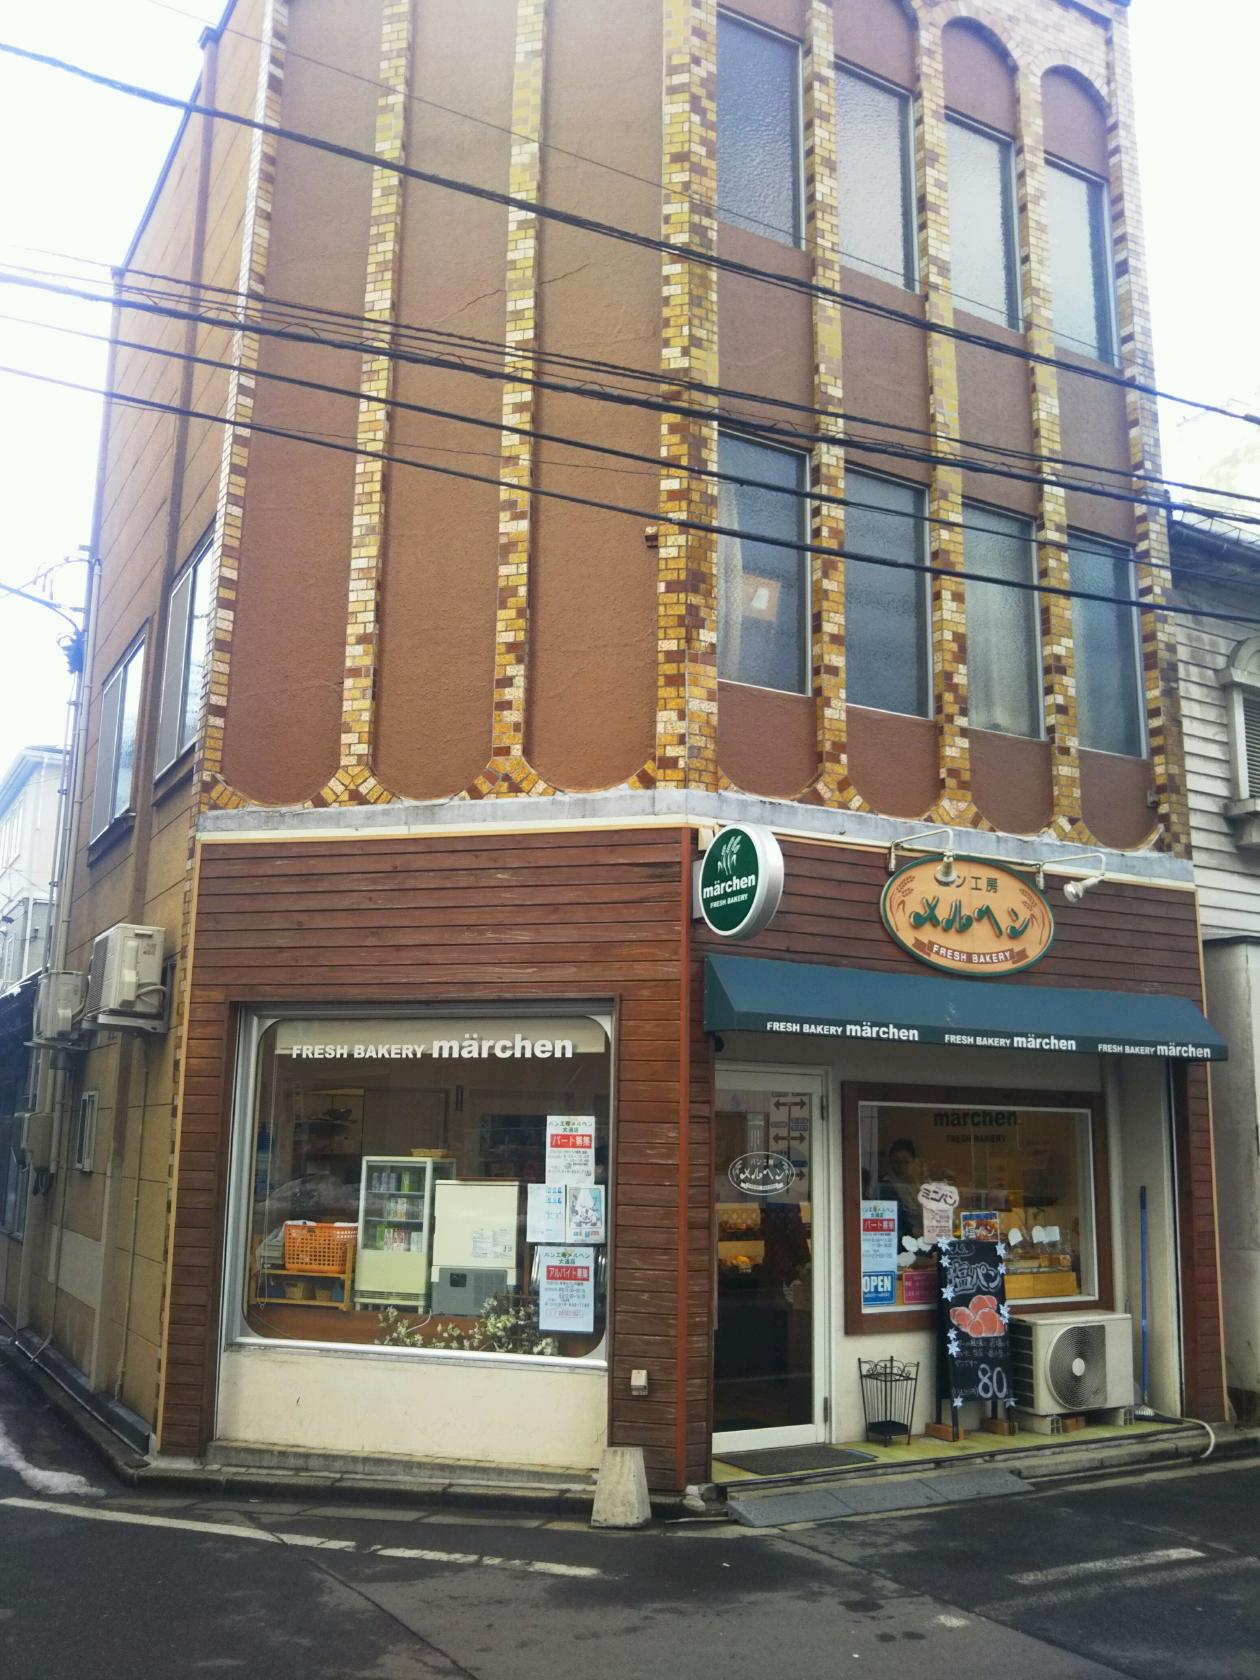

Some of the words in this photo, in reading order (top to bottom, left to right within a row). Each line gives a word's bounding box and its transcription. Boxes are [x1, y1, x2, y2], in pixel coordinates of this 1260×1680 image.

[702, 874, 756, 899] märchen
[955, 875, 998, 894] ン工房
[709, 900, 727, 909] FRESH
[727, 893, 749, 905] BAKERY
[910, 896, 1031, 939] メルヘン
[932, 944, 967, 961] FRESH
[972, 950, 1012, 963] BAKERY
[766, 1021, 800, 1032] FRESH
[802, 1023, 843, 1036] BAKERY
[846, 1022, 919, 1041] märchen
[291, 1044, 348, 1059] FRESH
[353, 1044, 425, 1059] BAKERY
[432, 1033, 573, 1059] märchen
[944, 1034, 974, 1045] FRESH
[976, 1036, 1011, 1047] BAKERY
[1013, 1034, 1077, 1051] märchen
[1098, 1043, 1123, 1053] FRESH
[1125, 1045, 1155, 1055] BAKERY
[1156, 1042, 1211, 1058] märchen
[863, 1276, 892, 1292] OPEN
[947, 1262, 1000, 1293] 塩パン
